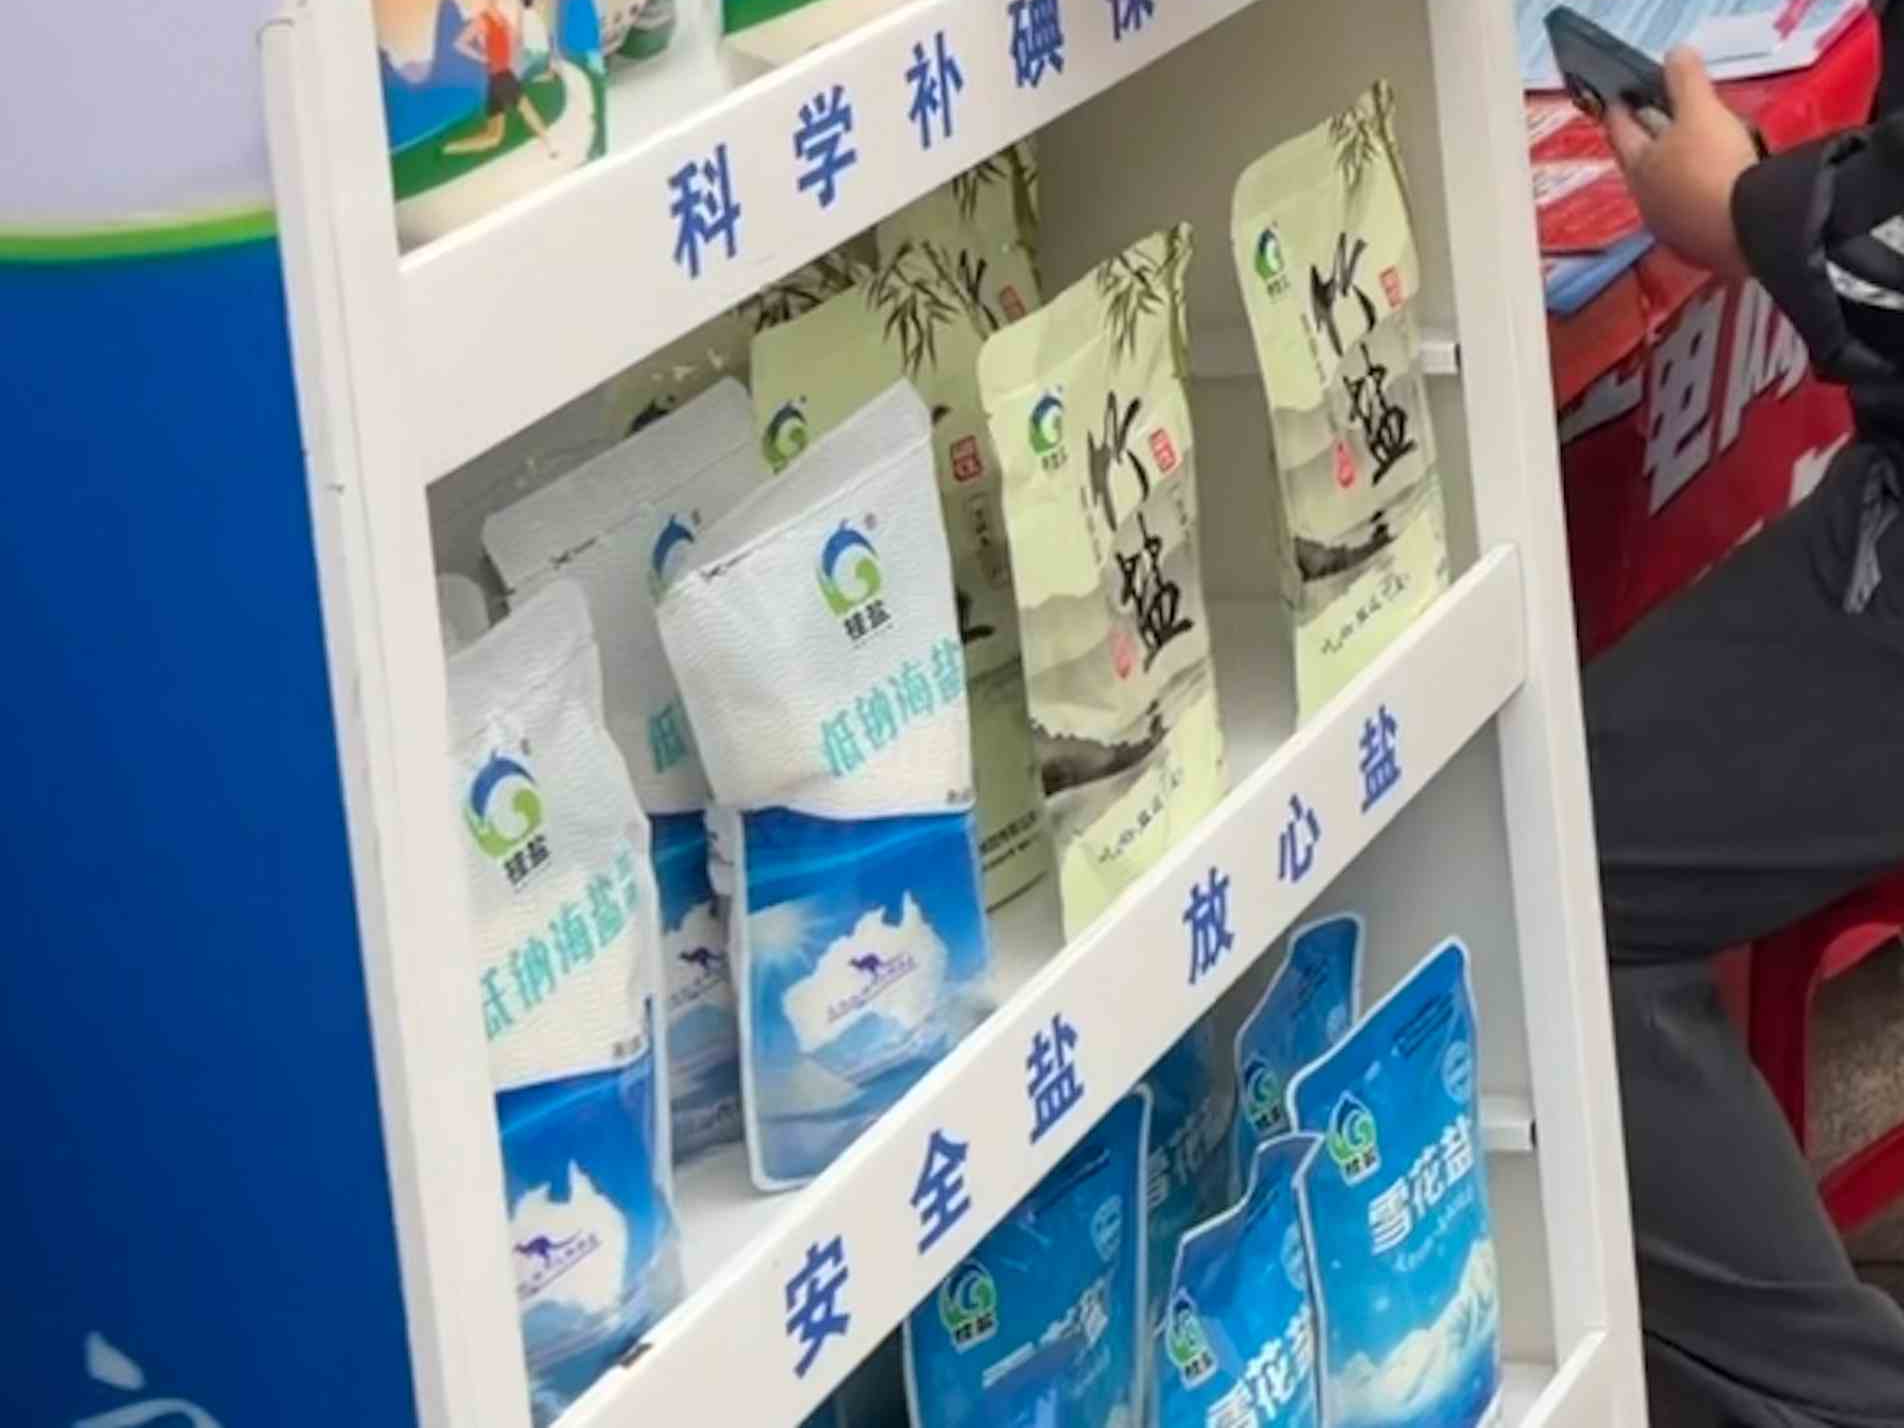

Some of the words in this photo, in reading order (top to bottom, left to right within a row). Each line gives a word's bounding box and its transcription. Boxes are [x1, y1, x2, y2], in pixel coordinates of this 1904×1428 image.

[819, 634, 964, 778] 低钠海盐
[785, 1011, 1085, 1380] 安全盐
[1183, 705, 1401, 985] 放心盐
[1368, 1114, 1476, 1257] 雪花盐
